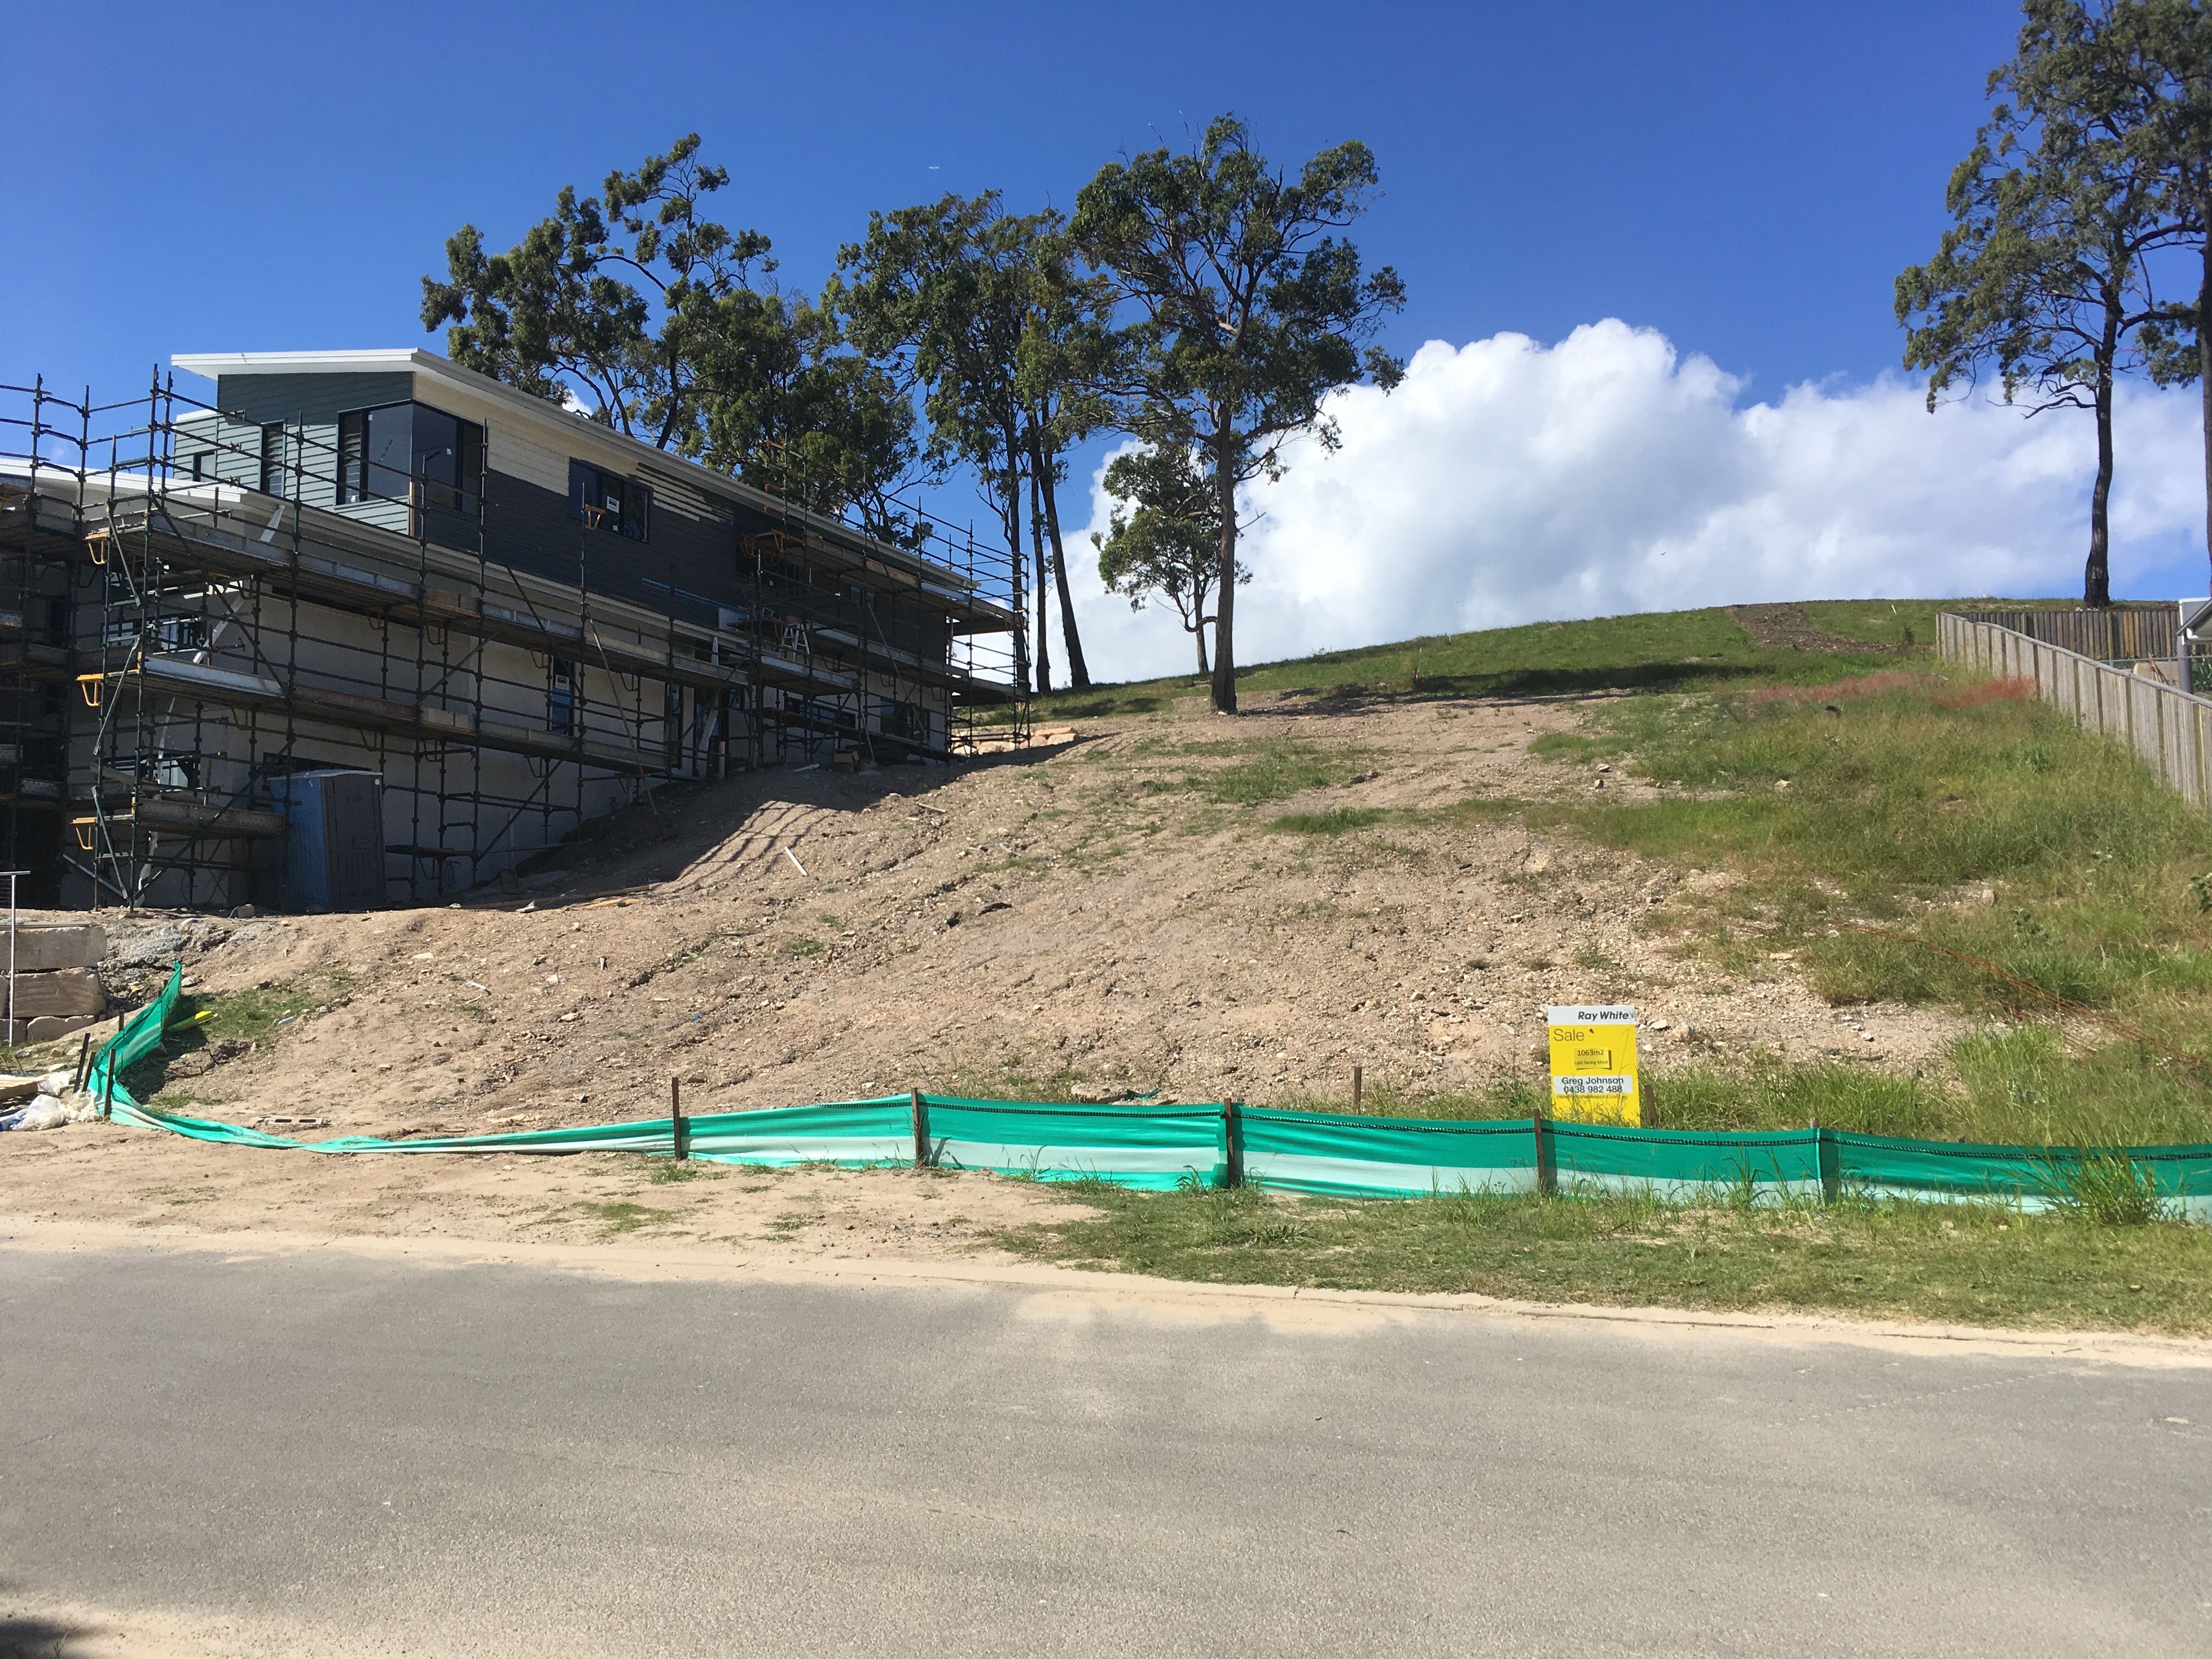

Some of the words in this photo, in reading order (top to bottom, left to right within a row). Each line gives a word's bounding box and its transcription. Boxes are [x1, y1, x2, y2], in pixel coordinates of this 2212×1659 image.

[1578, 1011, 1598, 1021] Ray
[1600, 1011, 1629, 1019] White
[1554, 1028, 1584, 1041] Sale
[1561, 1077, 1583, 1086] Greg
